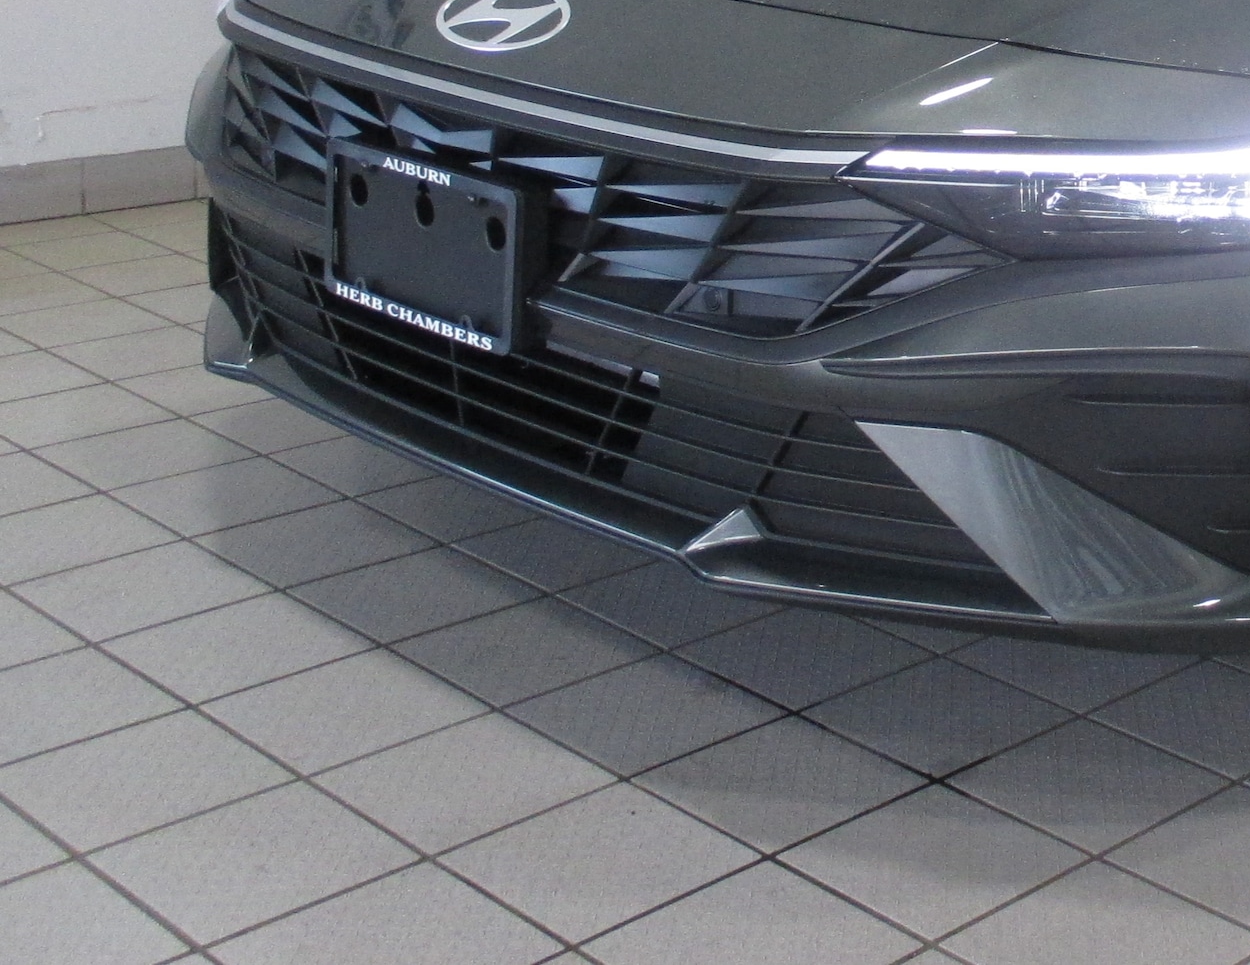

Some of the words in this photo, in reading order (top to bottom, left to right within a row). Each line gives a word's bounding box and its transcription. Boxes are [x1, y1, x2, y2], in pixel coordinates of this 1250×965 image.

[383, 157, 451, 186] AUBURN
[335, 283, 383, 311] HERB
[387, 303, 493, 350] CHAMBERS
